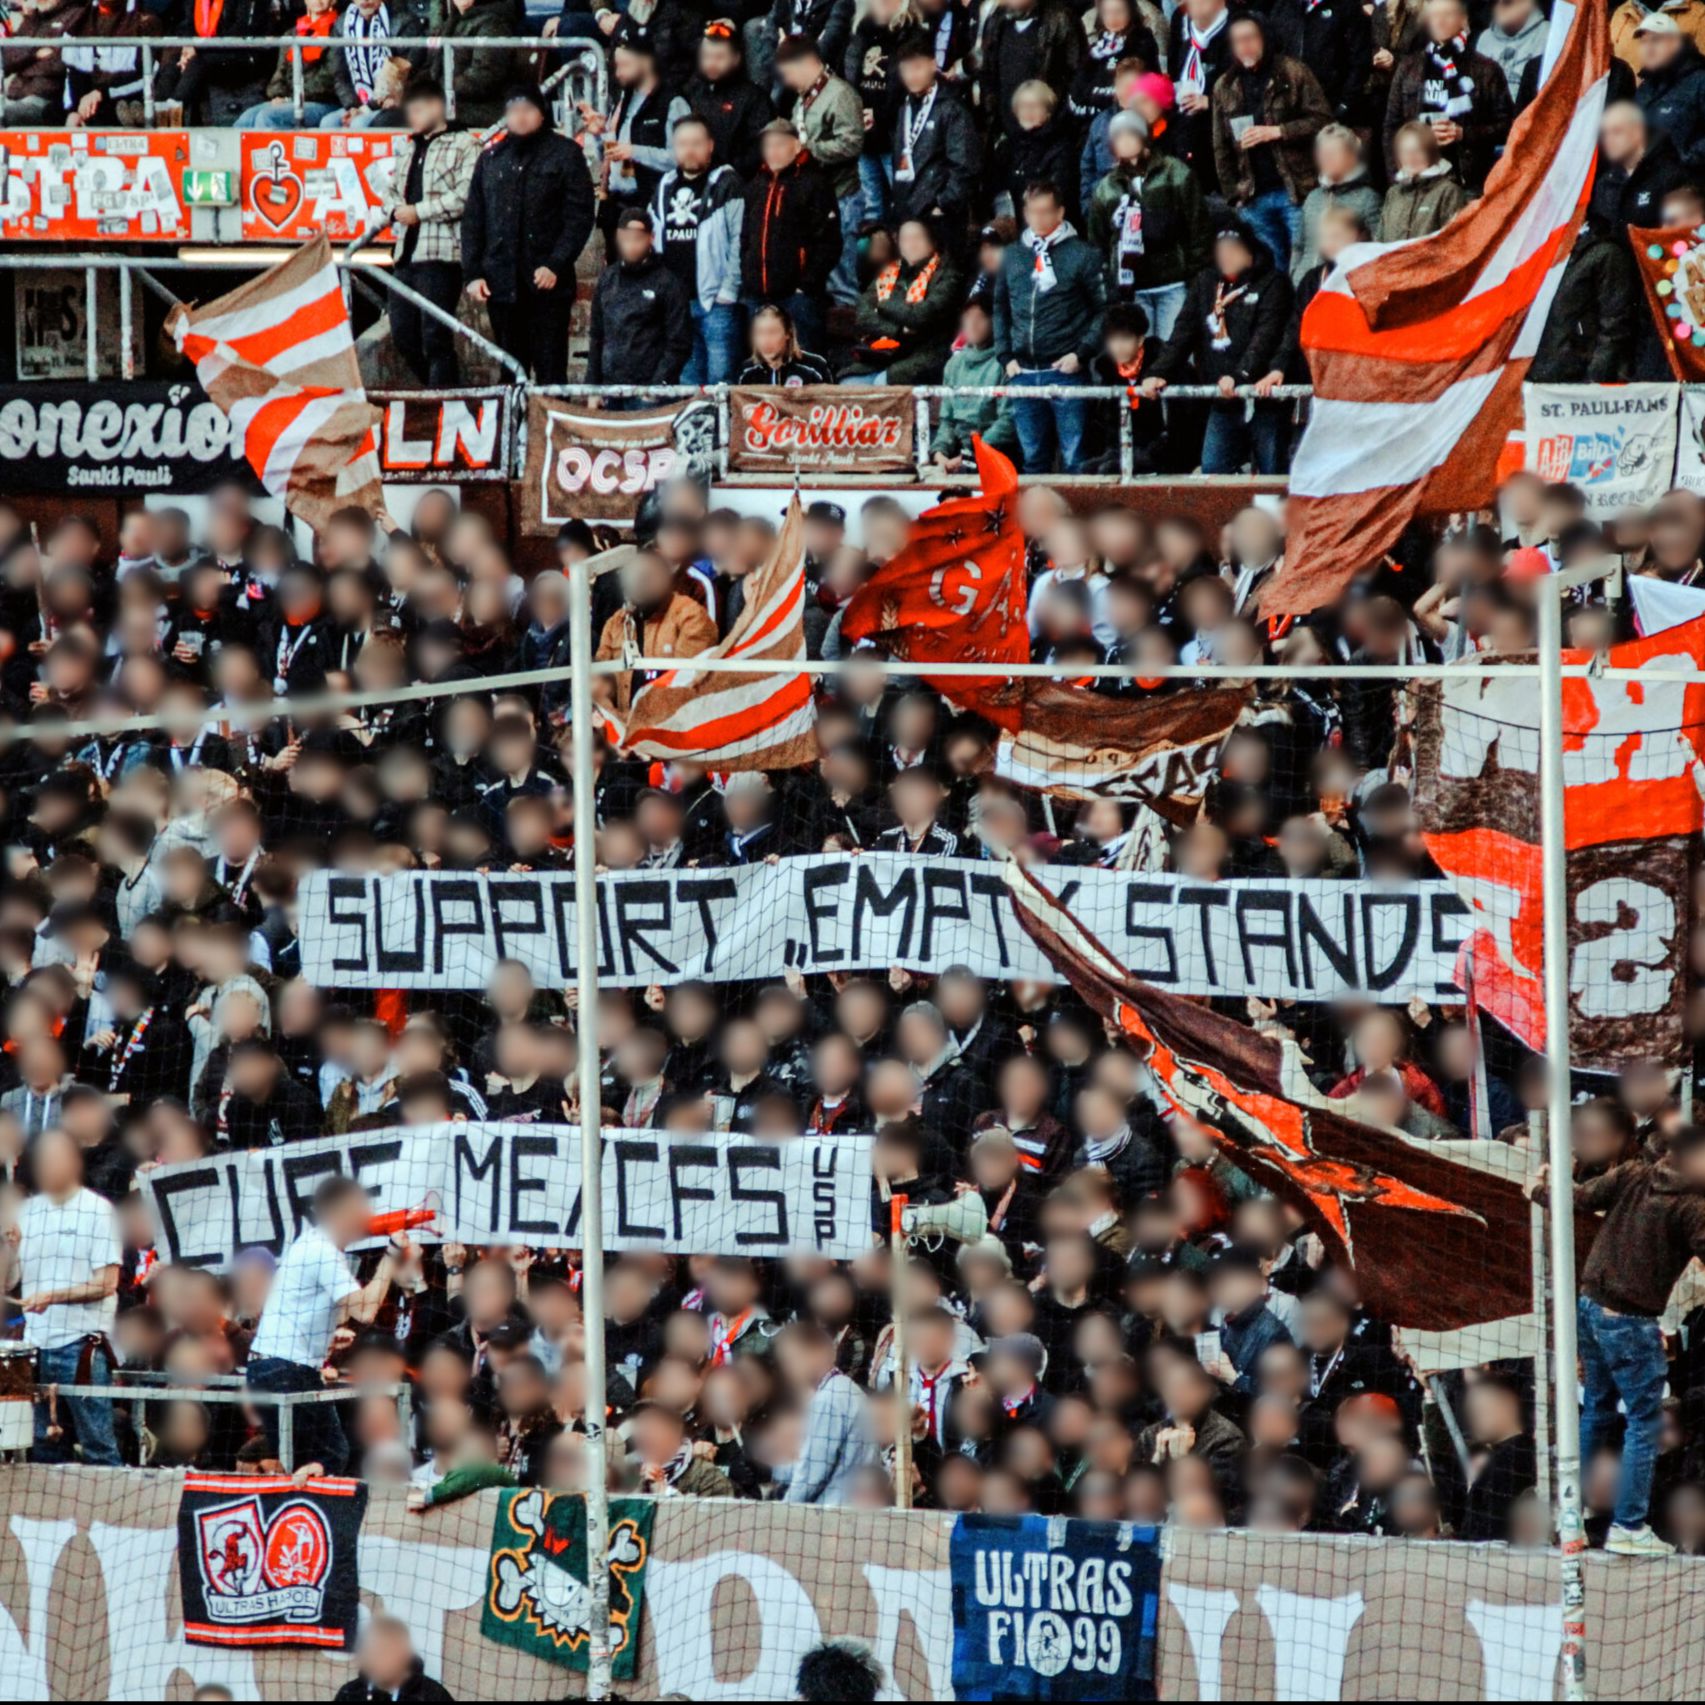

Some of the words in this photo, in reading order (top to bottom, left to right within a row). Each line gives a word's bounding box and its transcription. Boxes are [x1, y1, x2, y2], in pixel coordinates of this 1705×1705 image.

[1541, 404, 1565, 417] ST.
[1571, 397, 1669, 416] PAULI-FANS
[67, 465, 121, 486] Sankt
[122, 465, 173, 486] Pauli
[328, 877, 738, 979] SUPPORT
[974, 1550, 1133, 1617] ULTRAS
[215, 1598, 265, 1614] ULTRAS
